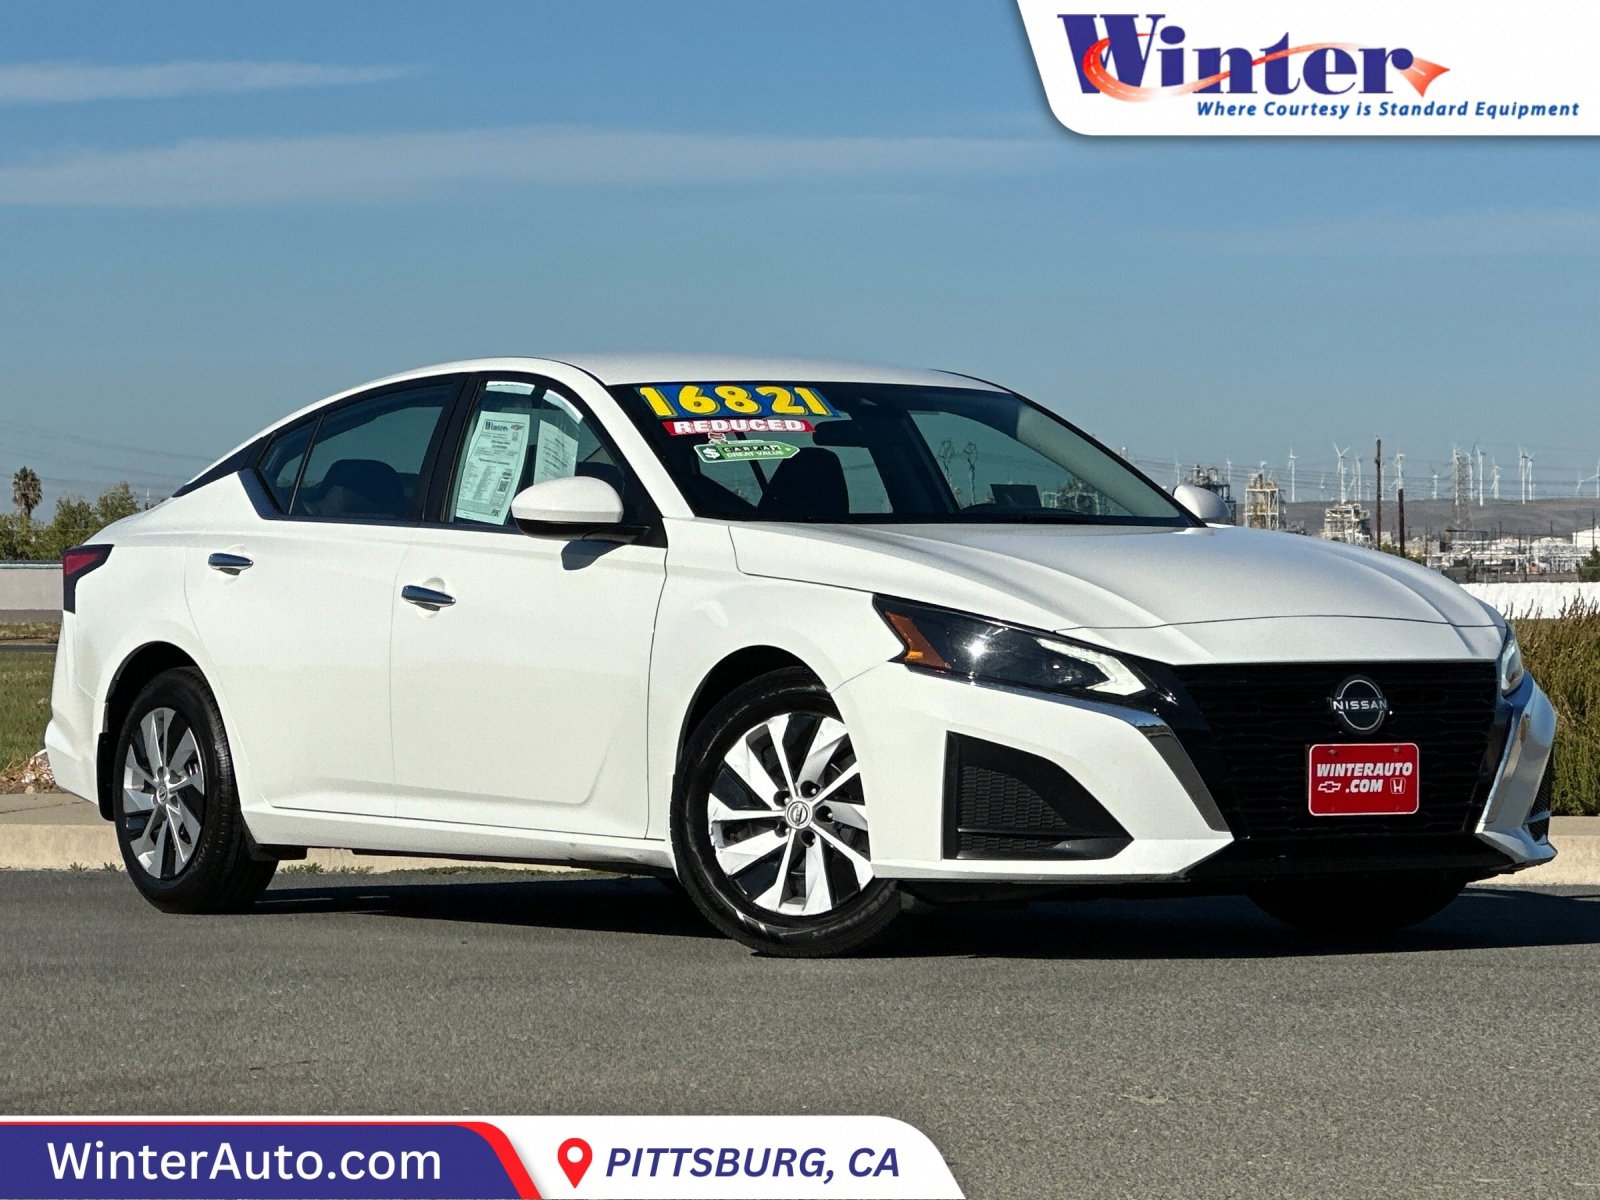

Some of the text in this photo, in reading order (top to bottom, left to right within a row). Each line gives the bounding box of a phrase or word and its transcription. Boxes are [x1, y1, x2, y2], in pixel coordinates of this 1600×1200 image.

[639, 385, 831, 417] 16821
[673, 419, 807, 435] REDUCED
[722, 444, 781, 453] CARFAX
[1333, 700, 1388, 711] NISSAN
[1316, 762, 1413, 778] WINTERAUTO
[1345, 779, 1384, 794] .COM
